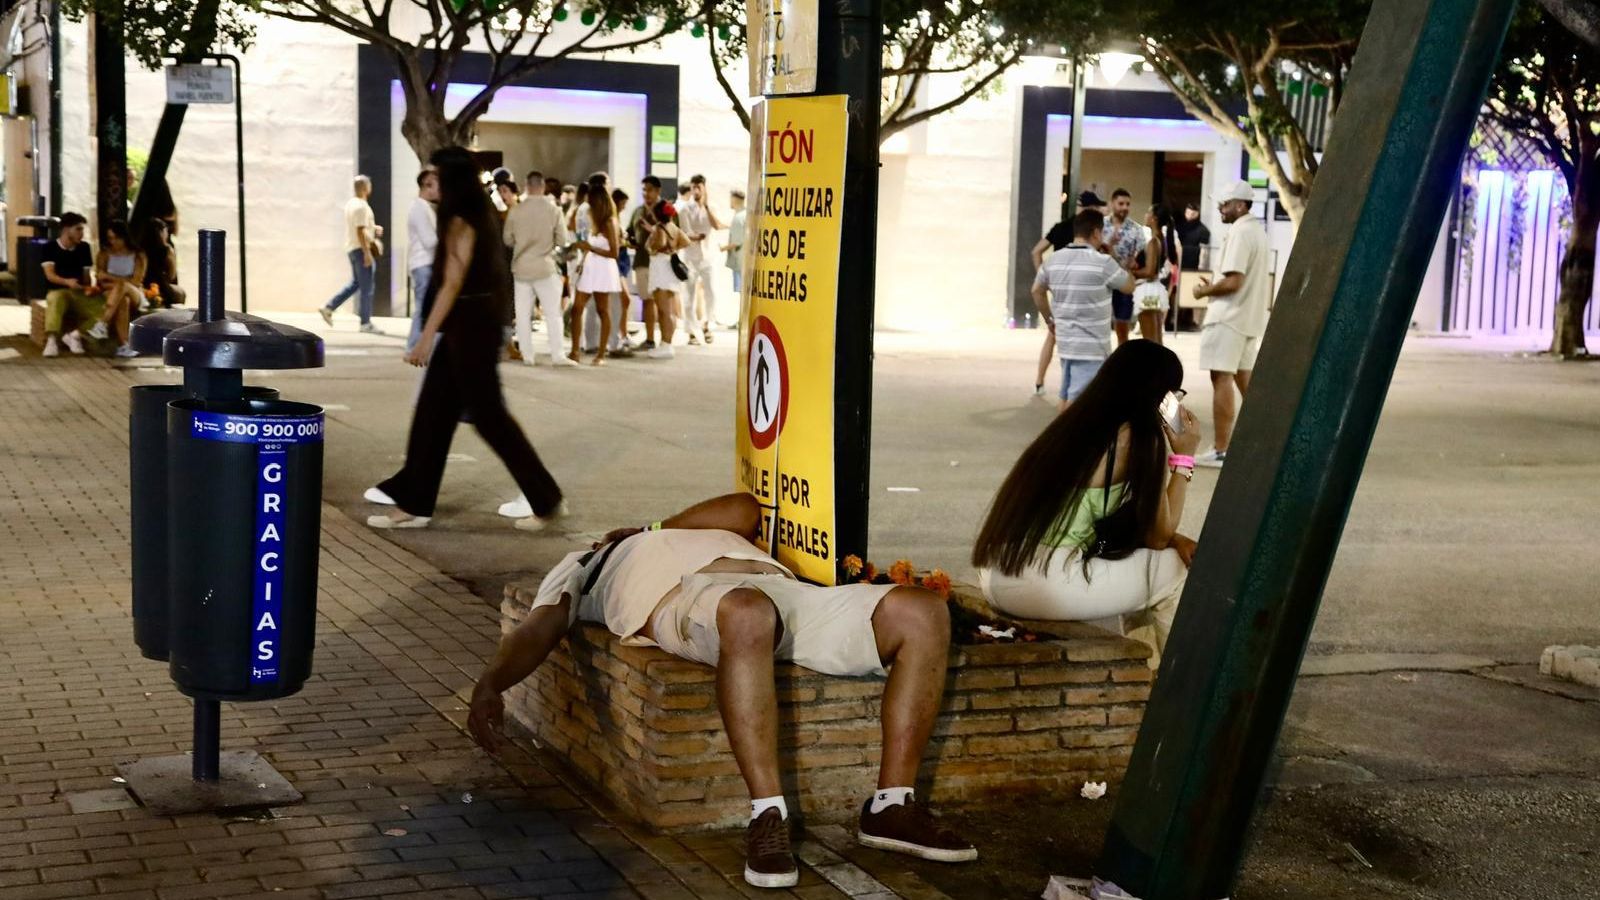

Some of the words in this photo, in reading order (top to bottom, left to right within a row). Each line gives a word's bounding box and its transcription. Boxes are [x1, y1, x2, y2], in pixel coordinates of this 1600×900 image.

[757, 121, 814, 164] TÓN
[787, 229, 807, 260] DE
[748, 265, 808, 302] ALLERÍAS
[224, 421, 259, 437] 900
[262, 424, 294, 437] 900
[297, 422, 319, 437] 000
[780, 472, 811, 508] POR
[754, 514, 830, 560] ATERALES
[256, 462, 282, 661] GRACIAS
